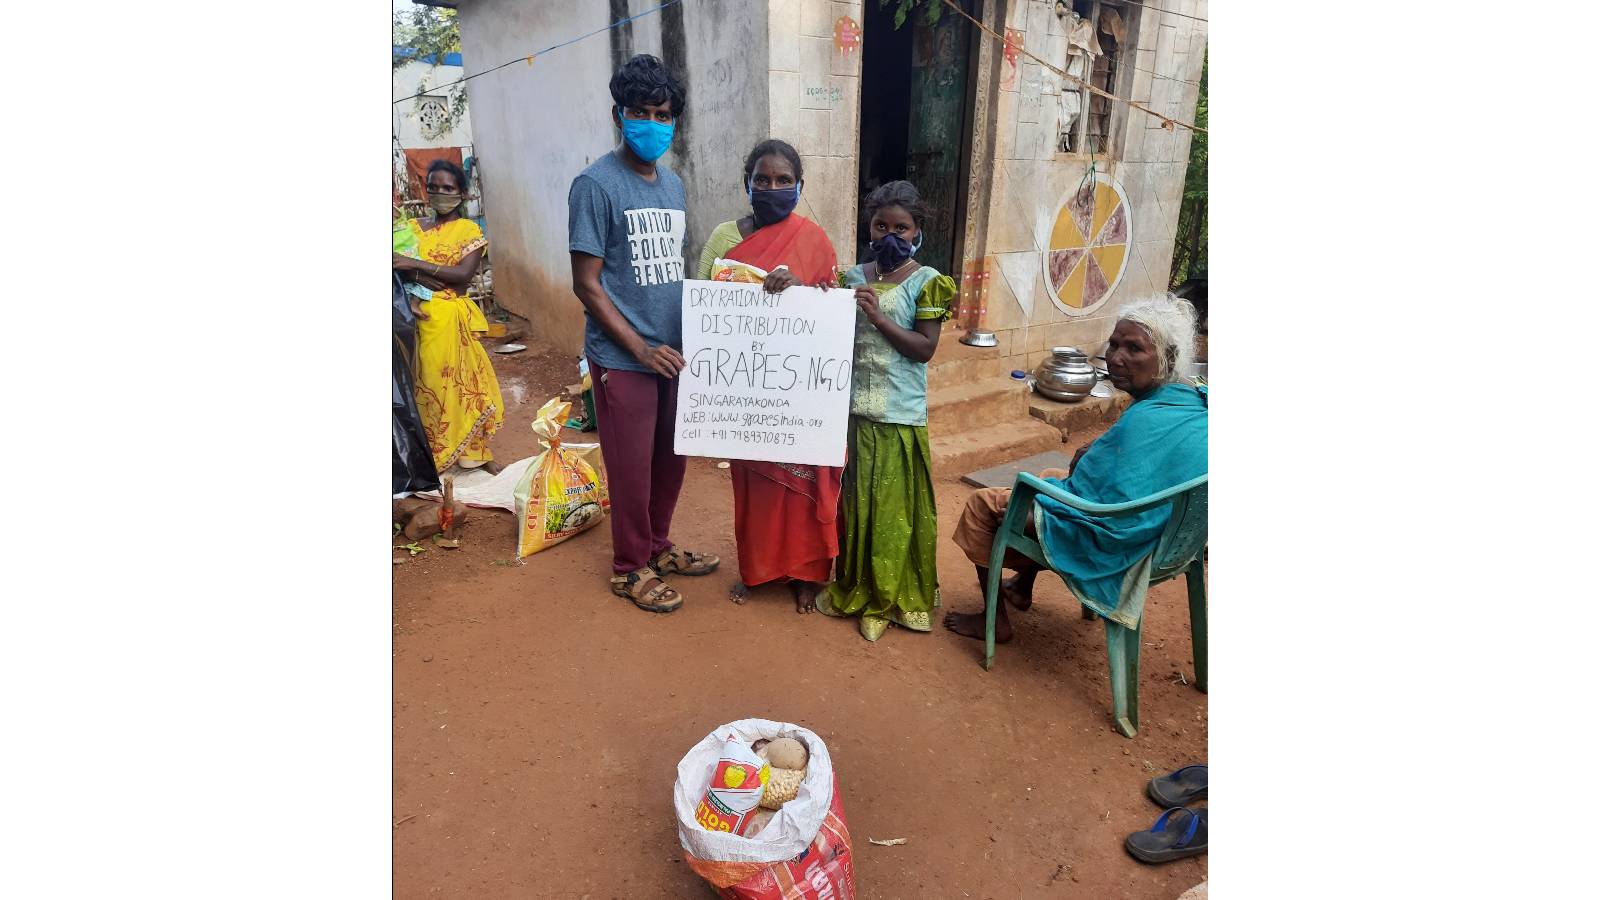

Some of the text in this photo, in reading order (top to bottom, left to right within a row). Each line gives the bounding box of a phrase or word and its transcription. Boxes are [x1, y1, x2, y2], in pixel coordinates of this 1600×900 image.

[629, 236, 686, 261] COLOR
[690, 287, 783, 308] DRY RATION KIT
[701, 314, 816, 336] DISTRIBUTION
[751, 341, 765, 352] BY
[689, 393, 790, 408] SINGARAYAKONDA
[712, 429, 727, 440] +91
